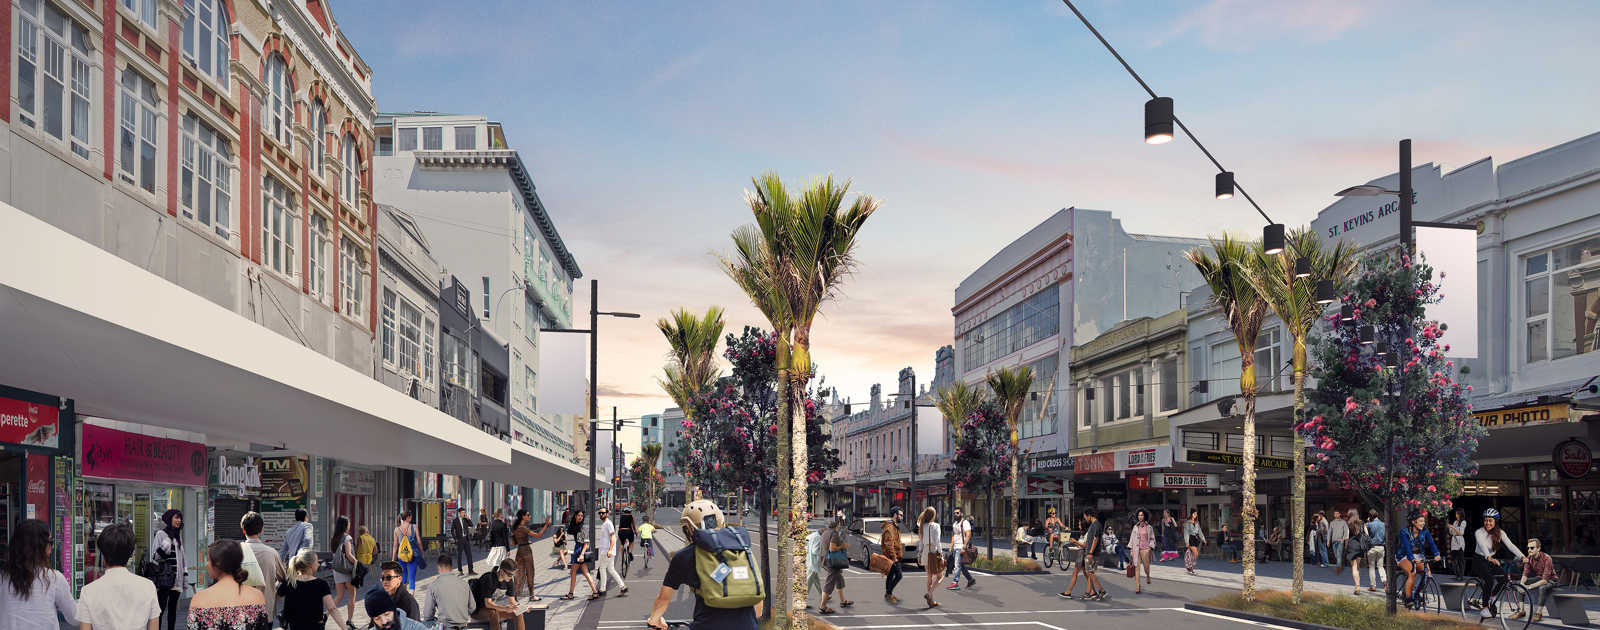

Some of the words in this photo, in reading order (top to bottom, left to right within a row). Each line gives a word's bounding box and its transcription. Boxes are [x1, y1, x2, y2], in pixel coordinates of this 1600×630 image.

[1328, 225, 1341, 238] ST.
[1343, 210, 1374, 233] KEVINS
[1377, 191, 1418, 219] ARCE
[1503, 409, 1550, 425] PHOTO
[262, 460, 290, 469] TM
[1164, 476, 1182, 485] LORD
[1190, 477, 1208, 485] FRIES
